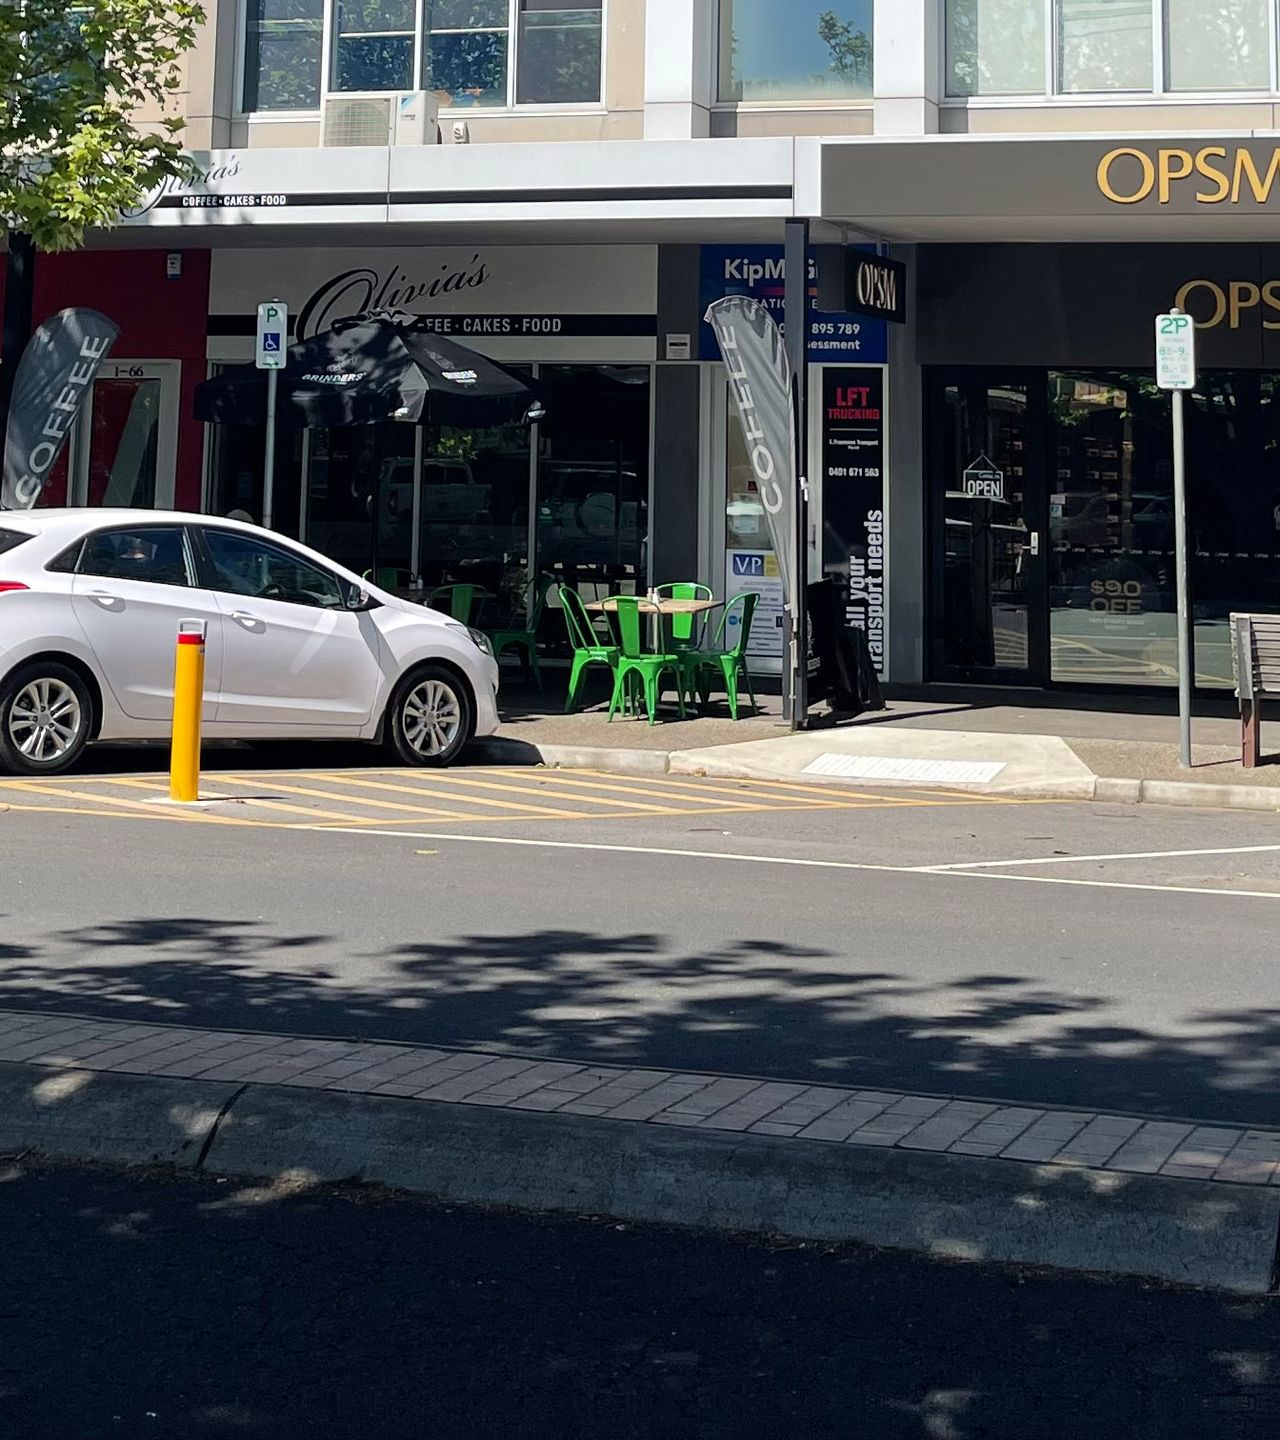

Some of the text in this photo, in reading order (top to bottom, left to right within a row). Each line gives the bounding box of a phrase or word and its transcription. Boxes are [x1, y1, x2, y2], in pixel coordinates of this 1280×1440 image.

[182, 195, 287, 207] COFFEE CAKES FOOD
[857, 261, 896, 312] OPSM
[463, 317, 510, 333] CAKES
[522, 317, 562, 333] FOOD
[811, 322, 861, 335] 895 789
[1160, 317, 1188, 334] 2P
[836, 387, 870, 406] LFT
[15, 335, 110, 509] COFFEE
[828, 408, 880, 420] TRUCKING
[967, 480, 1001, 497] OPEN
[863, 510, 883, 570] needs
[735, 556, 762, 574] VP
[849, 555, 869, 600] your
